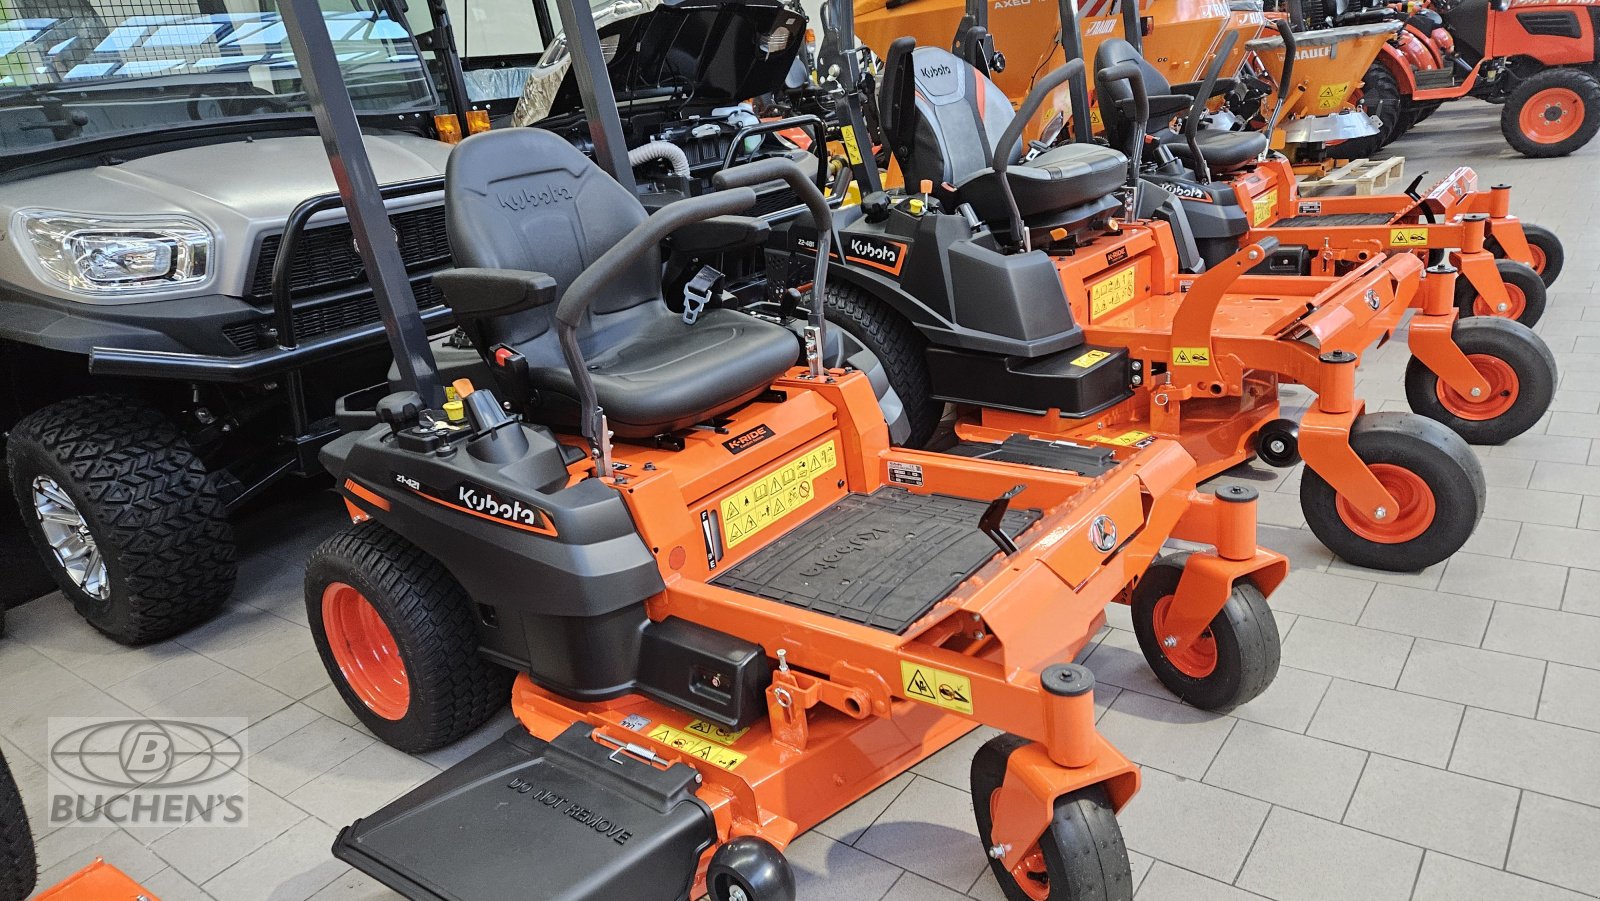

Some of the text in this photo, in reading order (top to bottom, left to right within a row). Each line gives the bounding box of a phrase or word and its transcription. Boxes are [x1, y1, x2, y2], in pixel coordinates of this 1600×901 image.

[920, 64, 951, 79] Kubota
[496, 184, 573, 211] Kubota
[1162, 183, 1204, 198] Kubota
[851, 239, 896, 262] Kubota
[728, 426, 767, 449] K-RIDE
[459, 486, 535, 525] Kubota
[701, 511, 708, 521] F
[709, 559, 716, 569] E
[507, 777, 633, 846] DO NOT REMOVE
